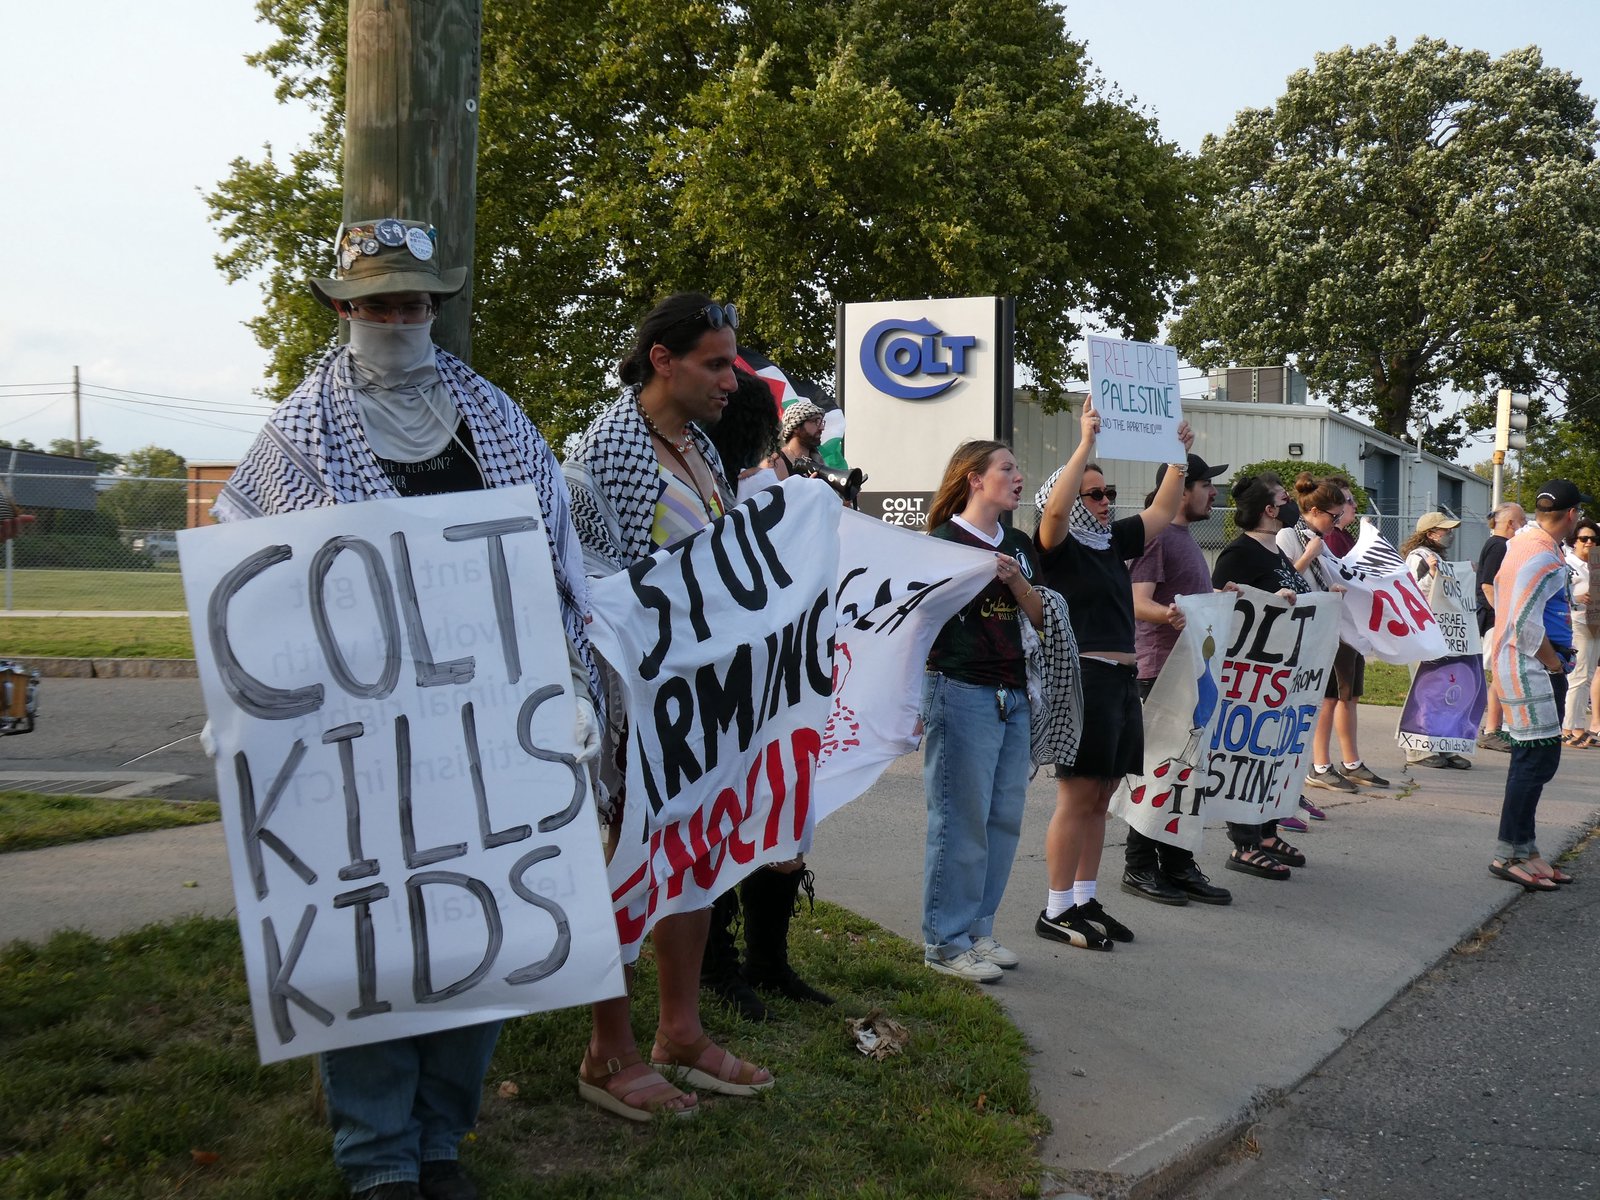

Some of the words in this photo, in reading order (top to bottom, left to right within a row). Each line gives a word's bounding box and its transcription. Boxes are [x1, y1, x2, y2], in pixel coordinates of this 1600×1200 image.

[860, 317, 976, 399] COLT
[1091, 340, 1134, 378] FREE
[1136, 344, 1176, 386] FREE
[1101, 379, 1174, 419] PALESTINE
[1113, 418, 1126, 432] THE
[882, 498, 924, 511] COLT
[628, 485, 794, 681] STOP
[207, 516, 540, 720] COLT
[1225, 599, 1317, 668] OLT
[233, 684, 588, 901] KILLS
[1205, 752, 1285, 804] STINE
[261, 845, 573, 1044] KIDS
